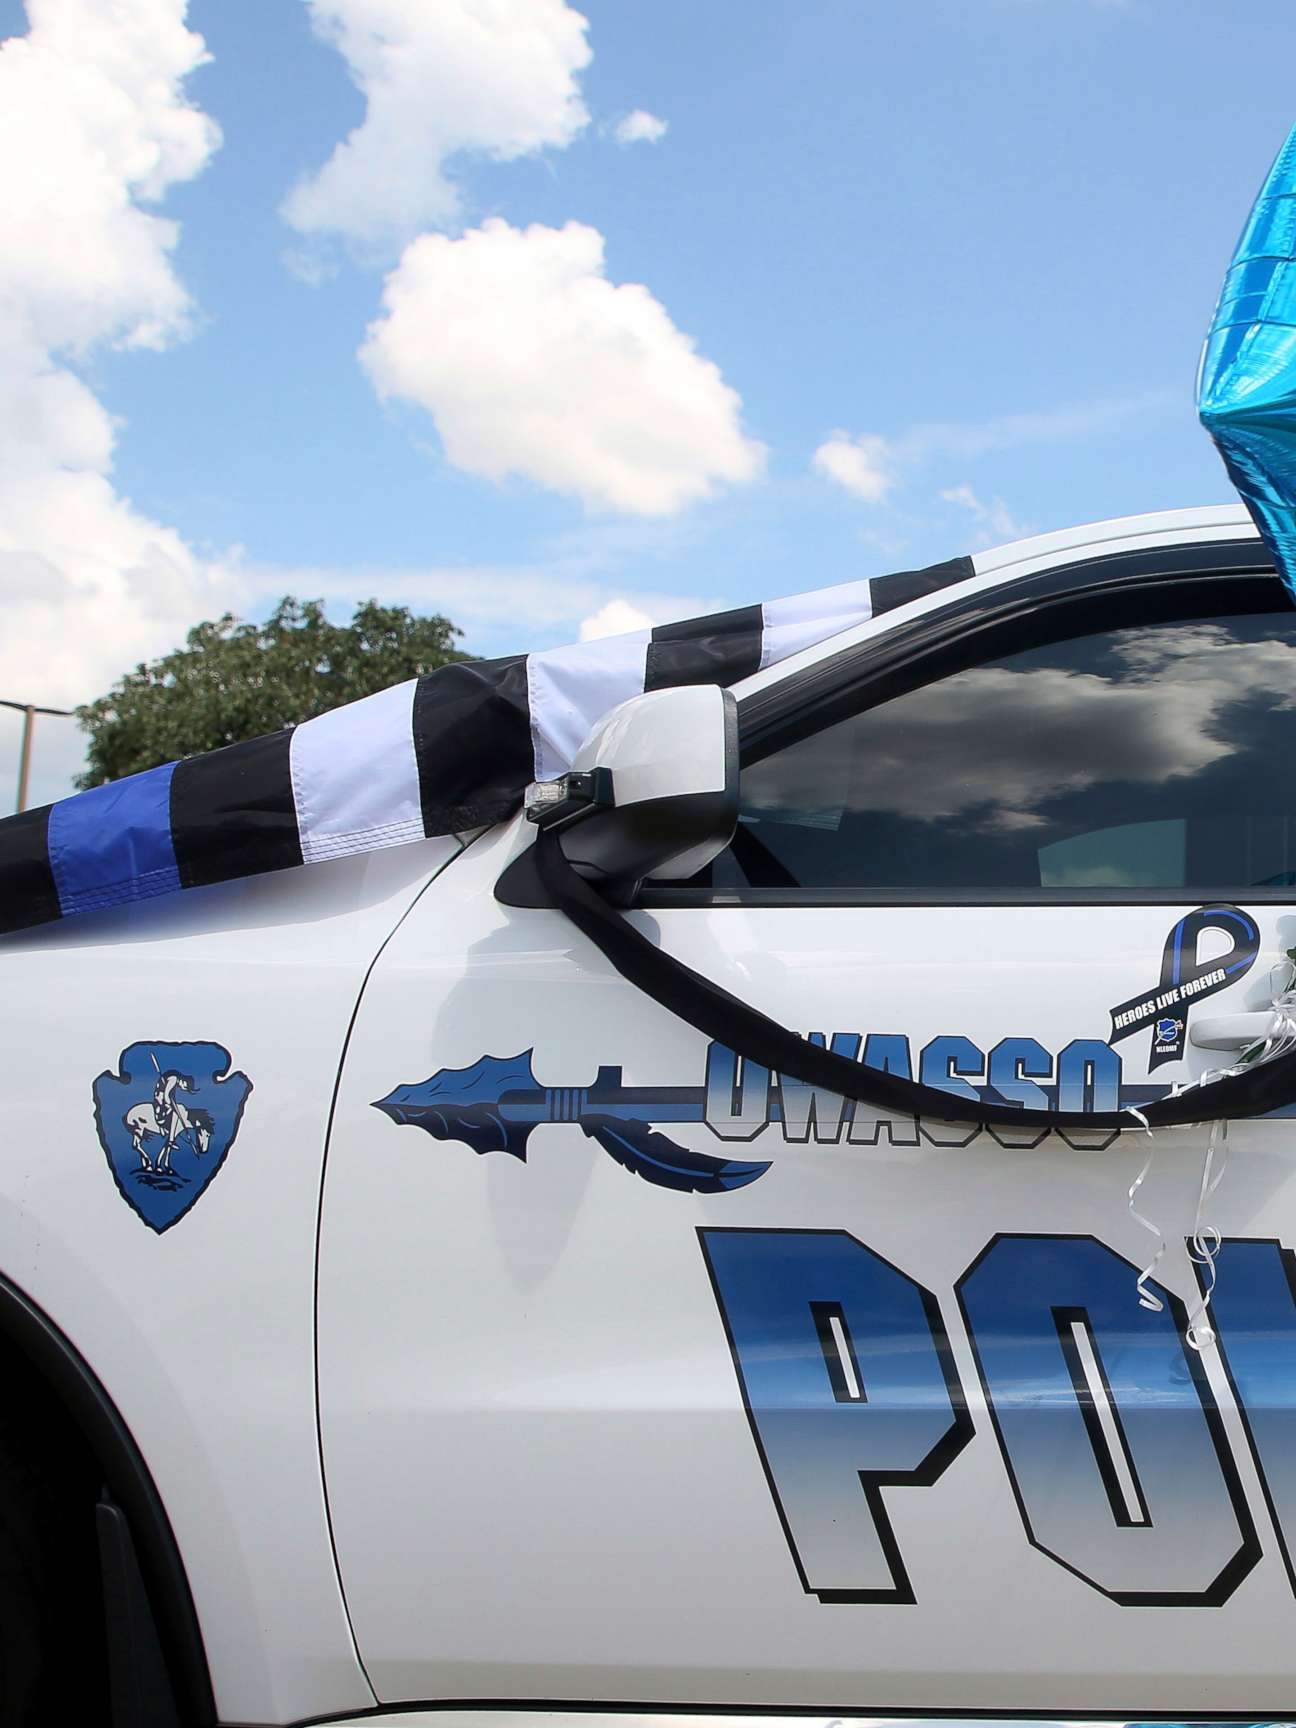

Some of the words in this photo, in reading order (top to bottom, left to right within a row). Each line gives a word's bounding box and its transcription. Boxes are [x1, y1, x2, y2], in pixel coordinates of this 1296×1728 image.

[1114, 1001, 1156, 1030] HEROES
[1156, 988, 1181, 1010] LIVE
[1180, 968, 1227, 999] FOREVER
